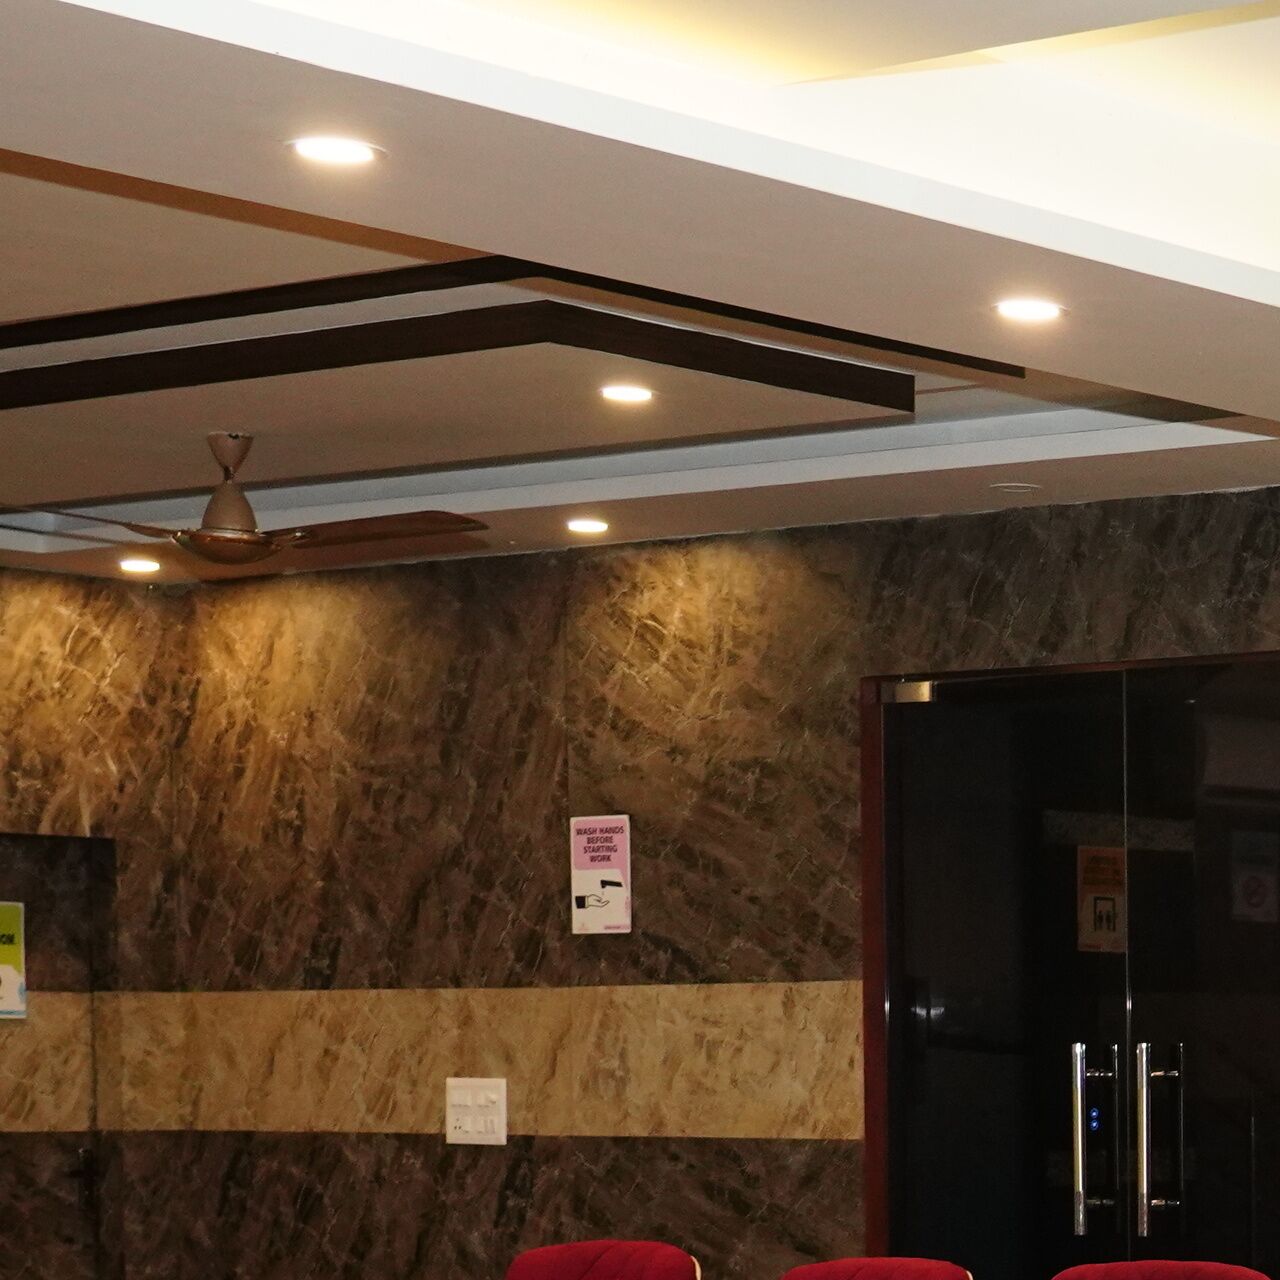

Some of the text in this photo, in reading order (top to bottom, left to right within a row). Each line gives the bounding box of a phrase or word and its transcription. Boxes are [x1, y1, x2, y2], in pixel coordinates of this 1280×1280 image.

[575, 825, 625, 836] WASH HANDS
[586, 835, 614, 844] BEFORE
[583, 844, 618, 854] STARTING
[589, 854, 612, 863] WORK
